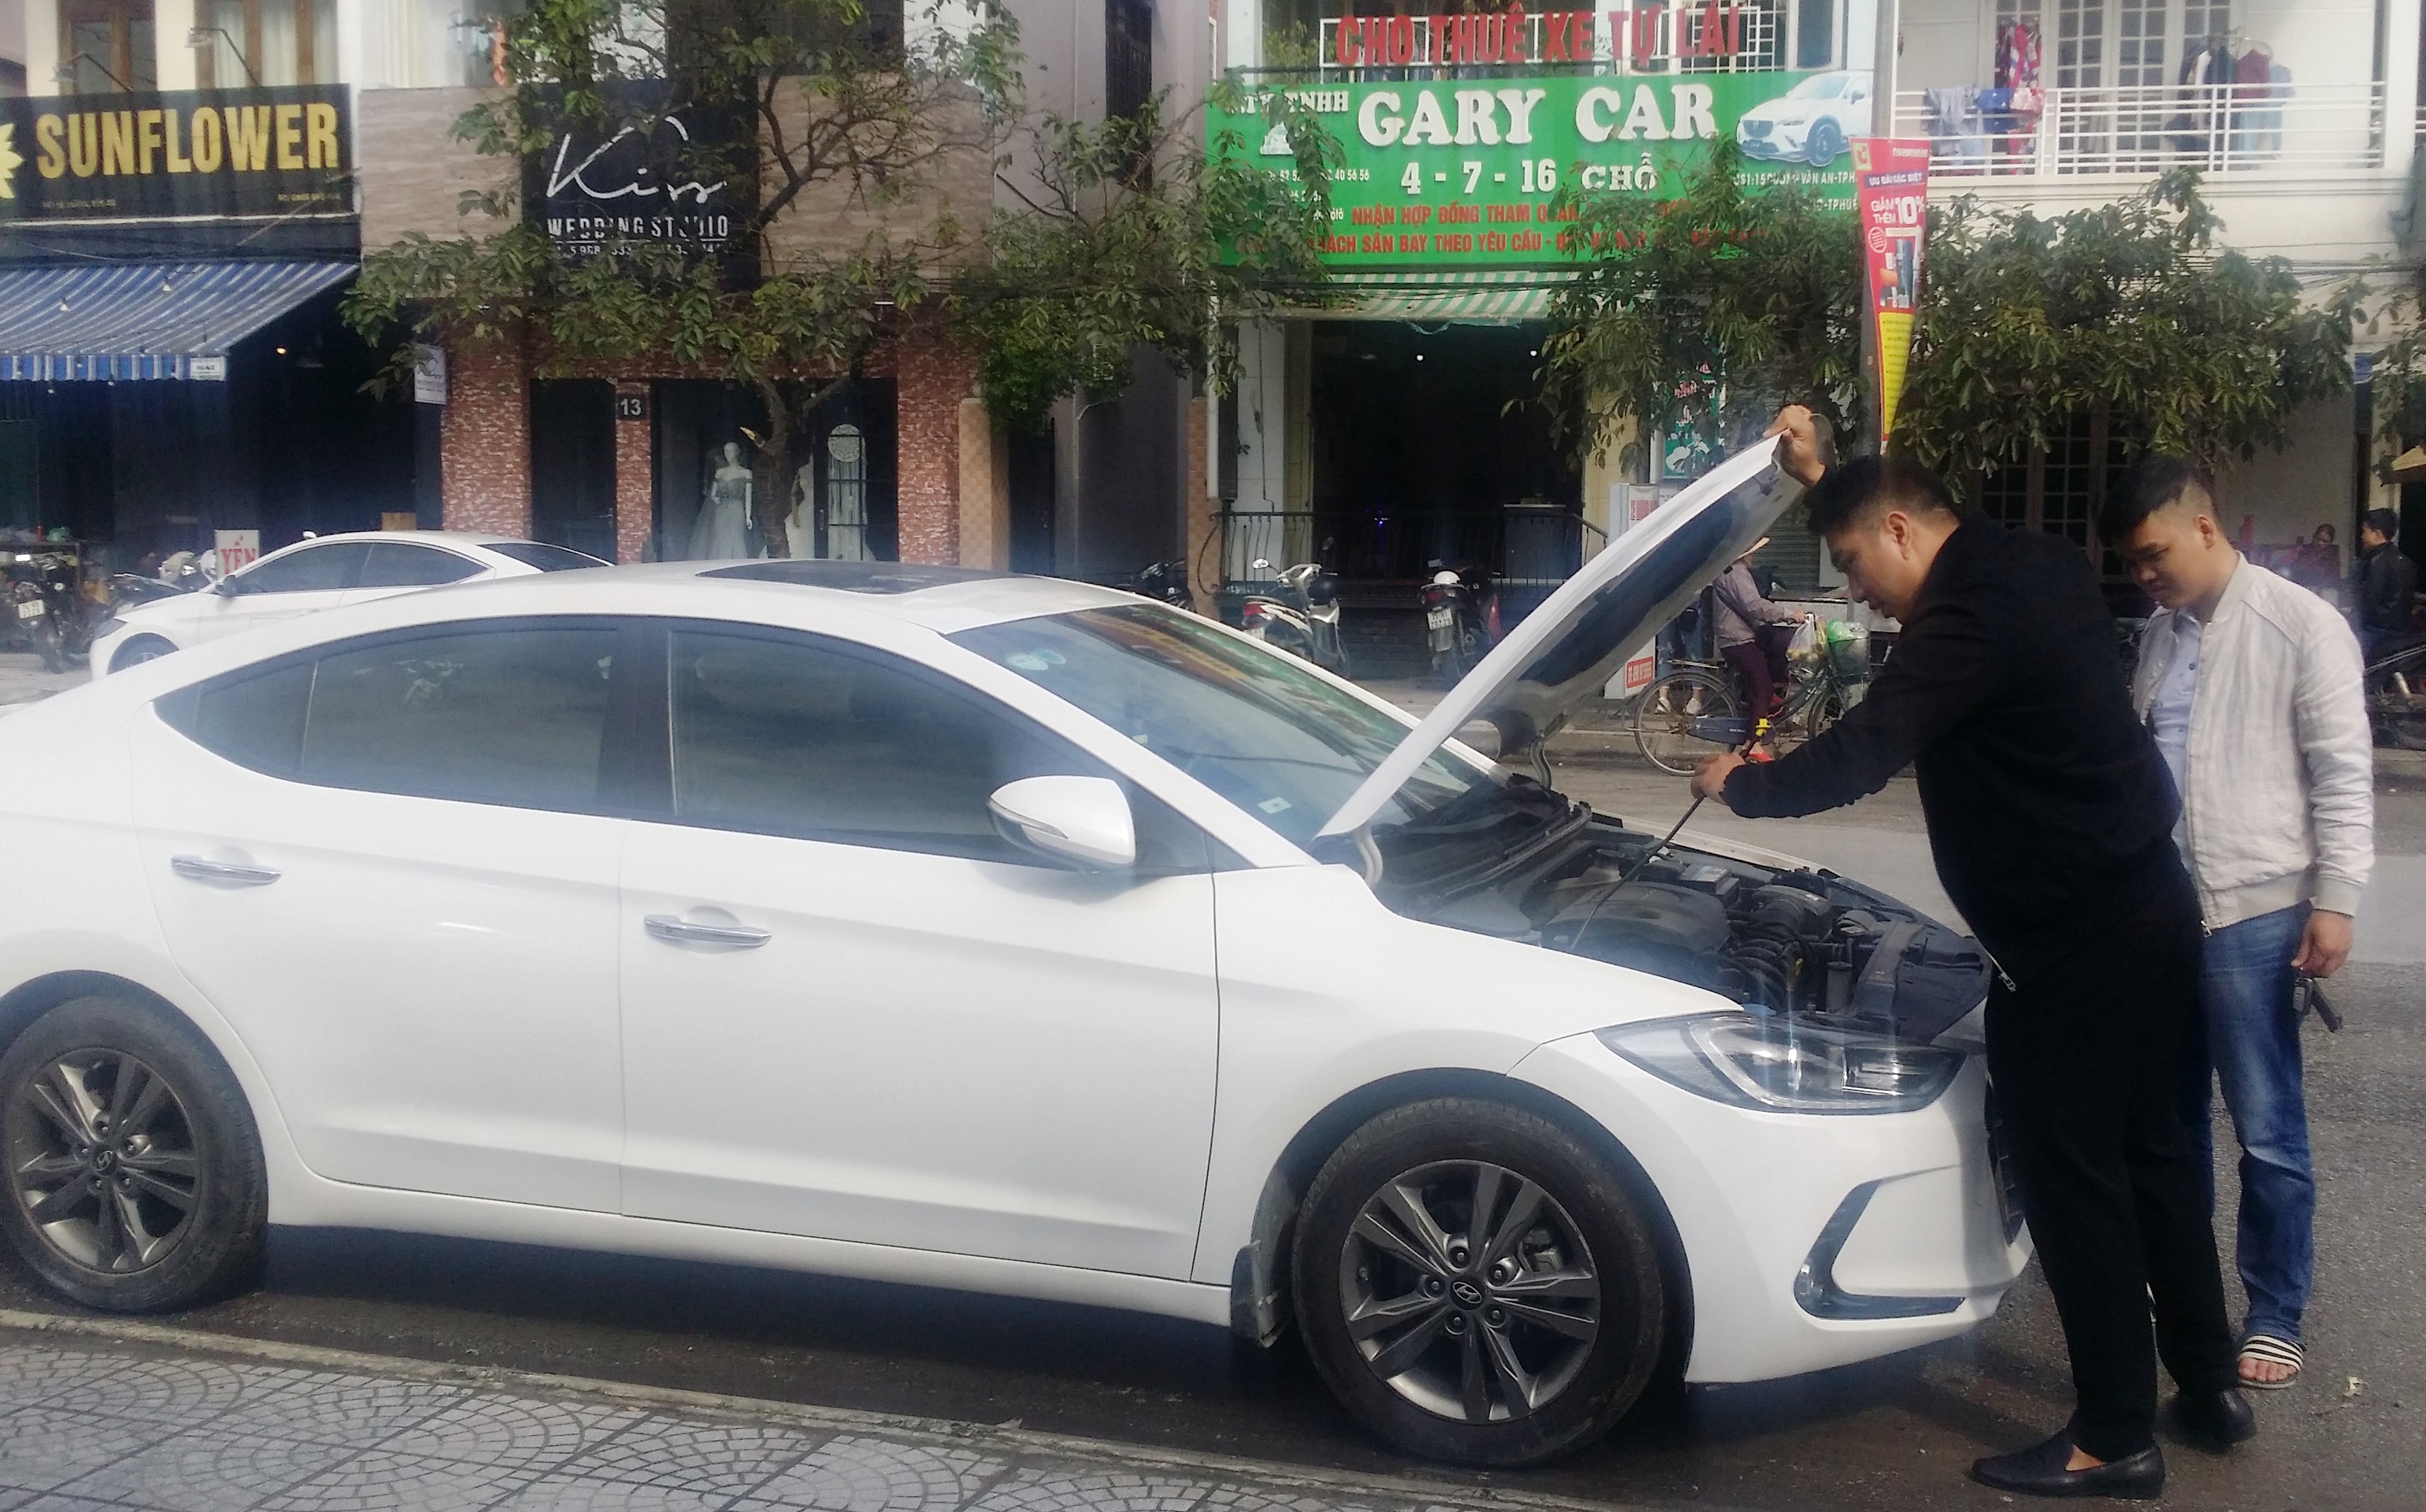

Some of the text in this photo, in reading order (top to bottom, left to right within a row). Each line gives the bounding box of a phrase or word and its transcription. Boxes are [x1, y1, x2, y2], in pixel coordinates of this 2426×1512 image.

[1336, 14, 1415, 65] CHO
[1428, 1, 1526, 64] THUÊ
[1543, 10, 1593, 62] XE
[1357, 82, 1719, 147] GARY CAR
[36, 102, 339, 179] SUNFLOWER
[1359, 169, 1370, 181] 56
[1400, 161, 1421, 195] 4
[1462, 161, 1482, 194] 7
[1521, 158, 1557, 193] 16
[1581, 151, 1658, 192] CHỖ
[1351, 202, 1395, 228] NHẬN
[1401, 203, 1432, 228] HỢP
[1486, 203, 1531, 223] THAM
[1400, 233, 1428, 252] BAY
[1435, 233, 1473, 252] THEO
[1477, 230, 1507, 252] YÊU
[620, 398, 642, 416] 13
